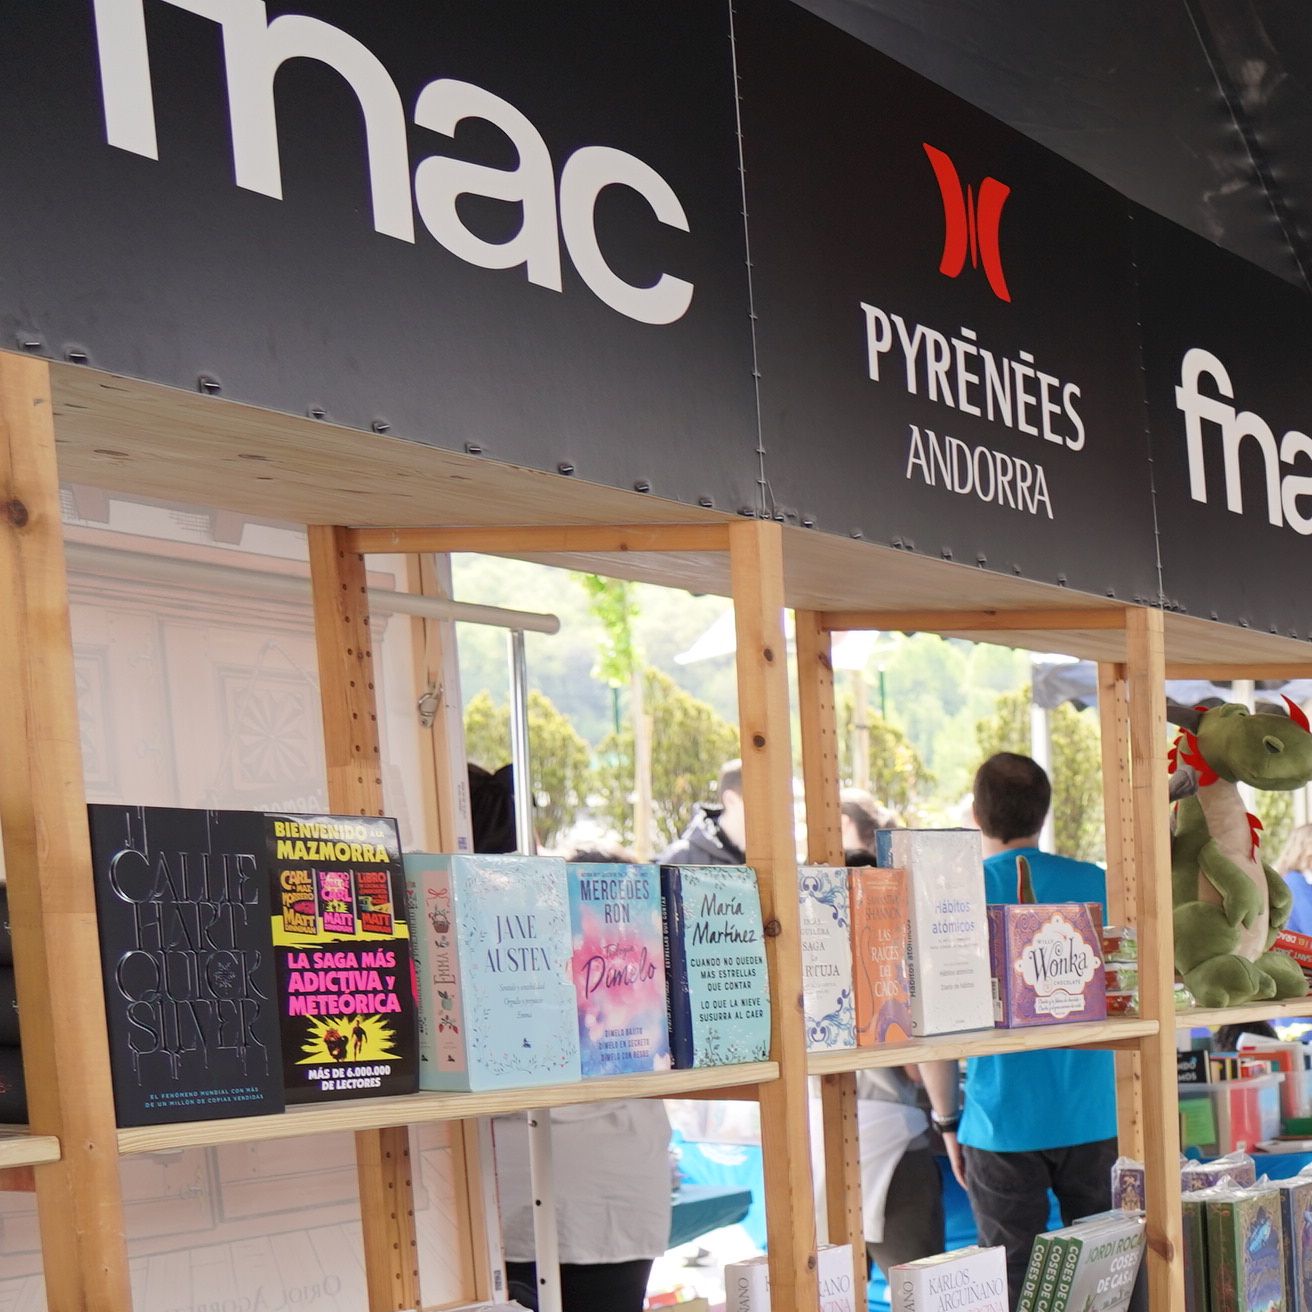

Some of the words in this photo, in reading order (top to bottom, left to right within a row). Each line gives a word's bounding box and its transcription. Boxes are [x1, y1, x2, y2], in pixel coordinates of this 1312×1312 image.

[906, 424, 1053, 520] ANDORRA
[274, 821, 368, 841] BIENVENIDO
[276, 839, 390, 863] MAZMORRA
[580, 879, 650, 901] MERCEDES
[605, 904, 631, 924] RON
[698, 892, 745, 917] María
[497, 914, 537, 943] JANE
[692, 919, 758, 947] Martínez
[931, 920, 976, 934] atómicos
[288, 952, 309, 969] LA
[313, 951, 358, 969] SAGA
[361, 947, 396, 968] MÁS
[433, 952, 456, 985] EMMA
[486, 947, 551, 973] AUSTEN
[690, 957, 721, 969] CUANDO
[723, 957, 737, 967] NO
[739, 956, 763, 967] QUEDEN
[1028, 937, 1088, 982] Wonka
[288, 971, 384, 993] ADICTIVA
[719, 968, 757, 979] ESTRELLAS
[707, 981, 723, 991] QUE
[725, 980, 752, 990] CONTAR
[288, 990, 401, 1016] METEÓRICA
[701, 1000, 712, 1010] LO
[715, 999, 729, 1009] QUE
[730, 998, 740, 1008] LA
[699, 1009, 733, 1022] SUSURRA
[745, 1007, 764, 1019] CAER
[308, 1066, 330, 1080] MÁS
[333, 1067, 345, 1079] DE
[346, 1065, 391, 1078] 6.000.000
[322, 1079, 335, 1091] DE
[337, 1077, 381, 1090] LECTORES
[1030, 1244, 1045, 1281] COSES
[1086, 1239, 1117, 1264] JORDI
[1110, 1251, 1138, 1273] COSES
[1047, 1245, 1062, 1282] COSES
[1063, 1245, 1079, 1282] COSES
[928, 1269, 971, 1296] KARLOS
[1025, 1283, 1036, 1299] DE
[1042, 1284, 1053, 1299] DE
[1059, 1285, 1070, 1300] DE
[1096, 1278, 1109, 1294] DE
[1110, 1271, 1133, 1290] CASA
